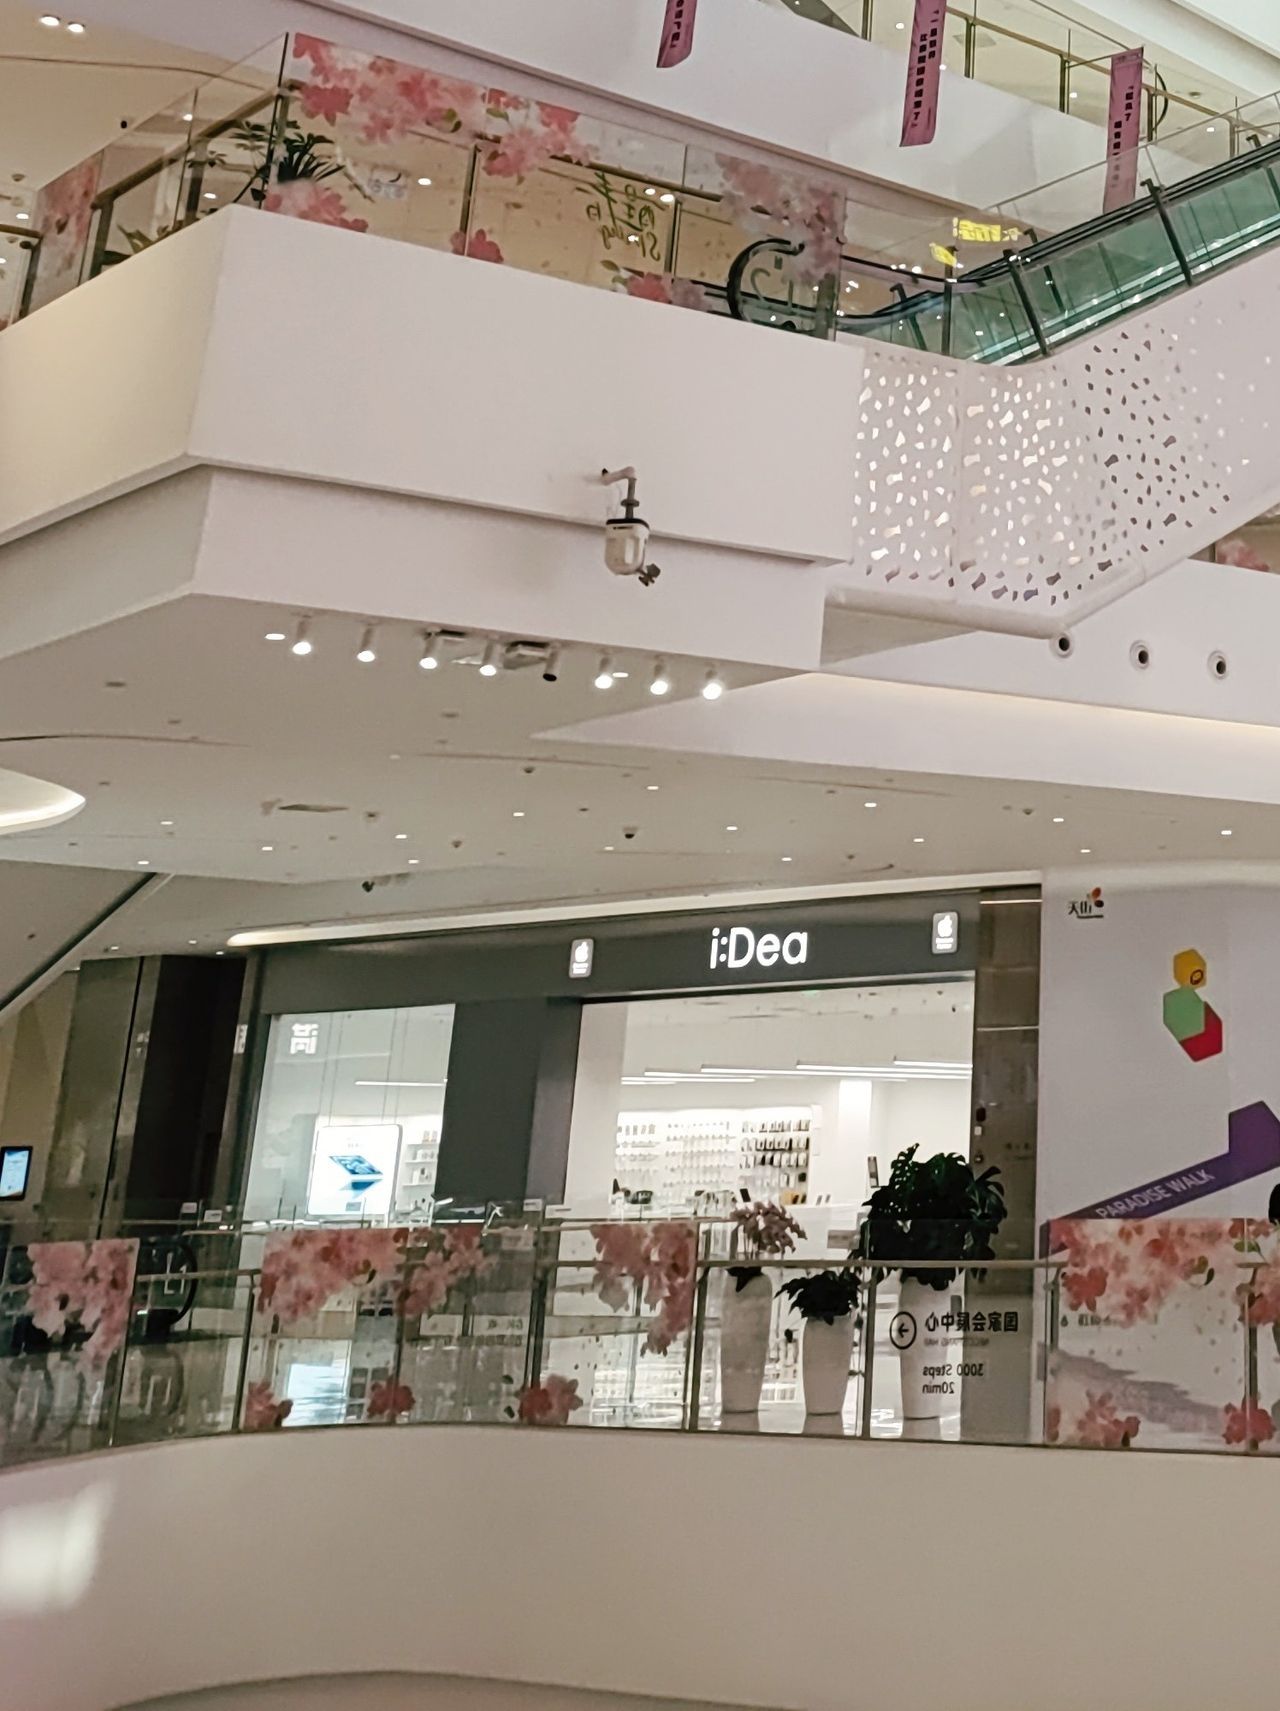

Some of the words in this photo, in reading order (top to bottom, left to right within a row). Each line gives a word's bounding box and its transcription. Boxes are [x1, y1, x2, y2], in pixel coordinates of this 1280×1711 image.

[710, 927, 808, 969] i:Dea
[1095, 1185, 1172, 1218] PARADISE
[1165, 1169, 1216, 1192] WALK
